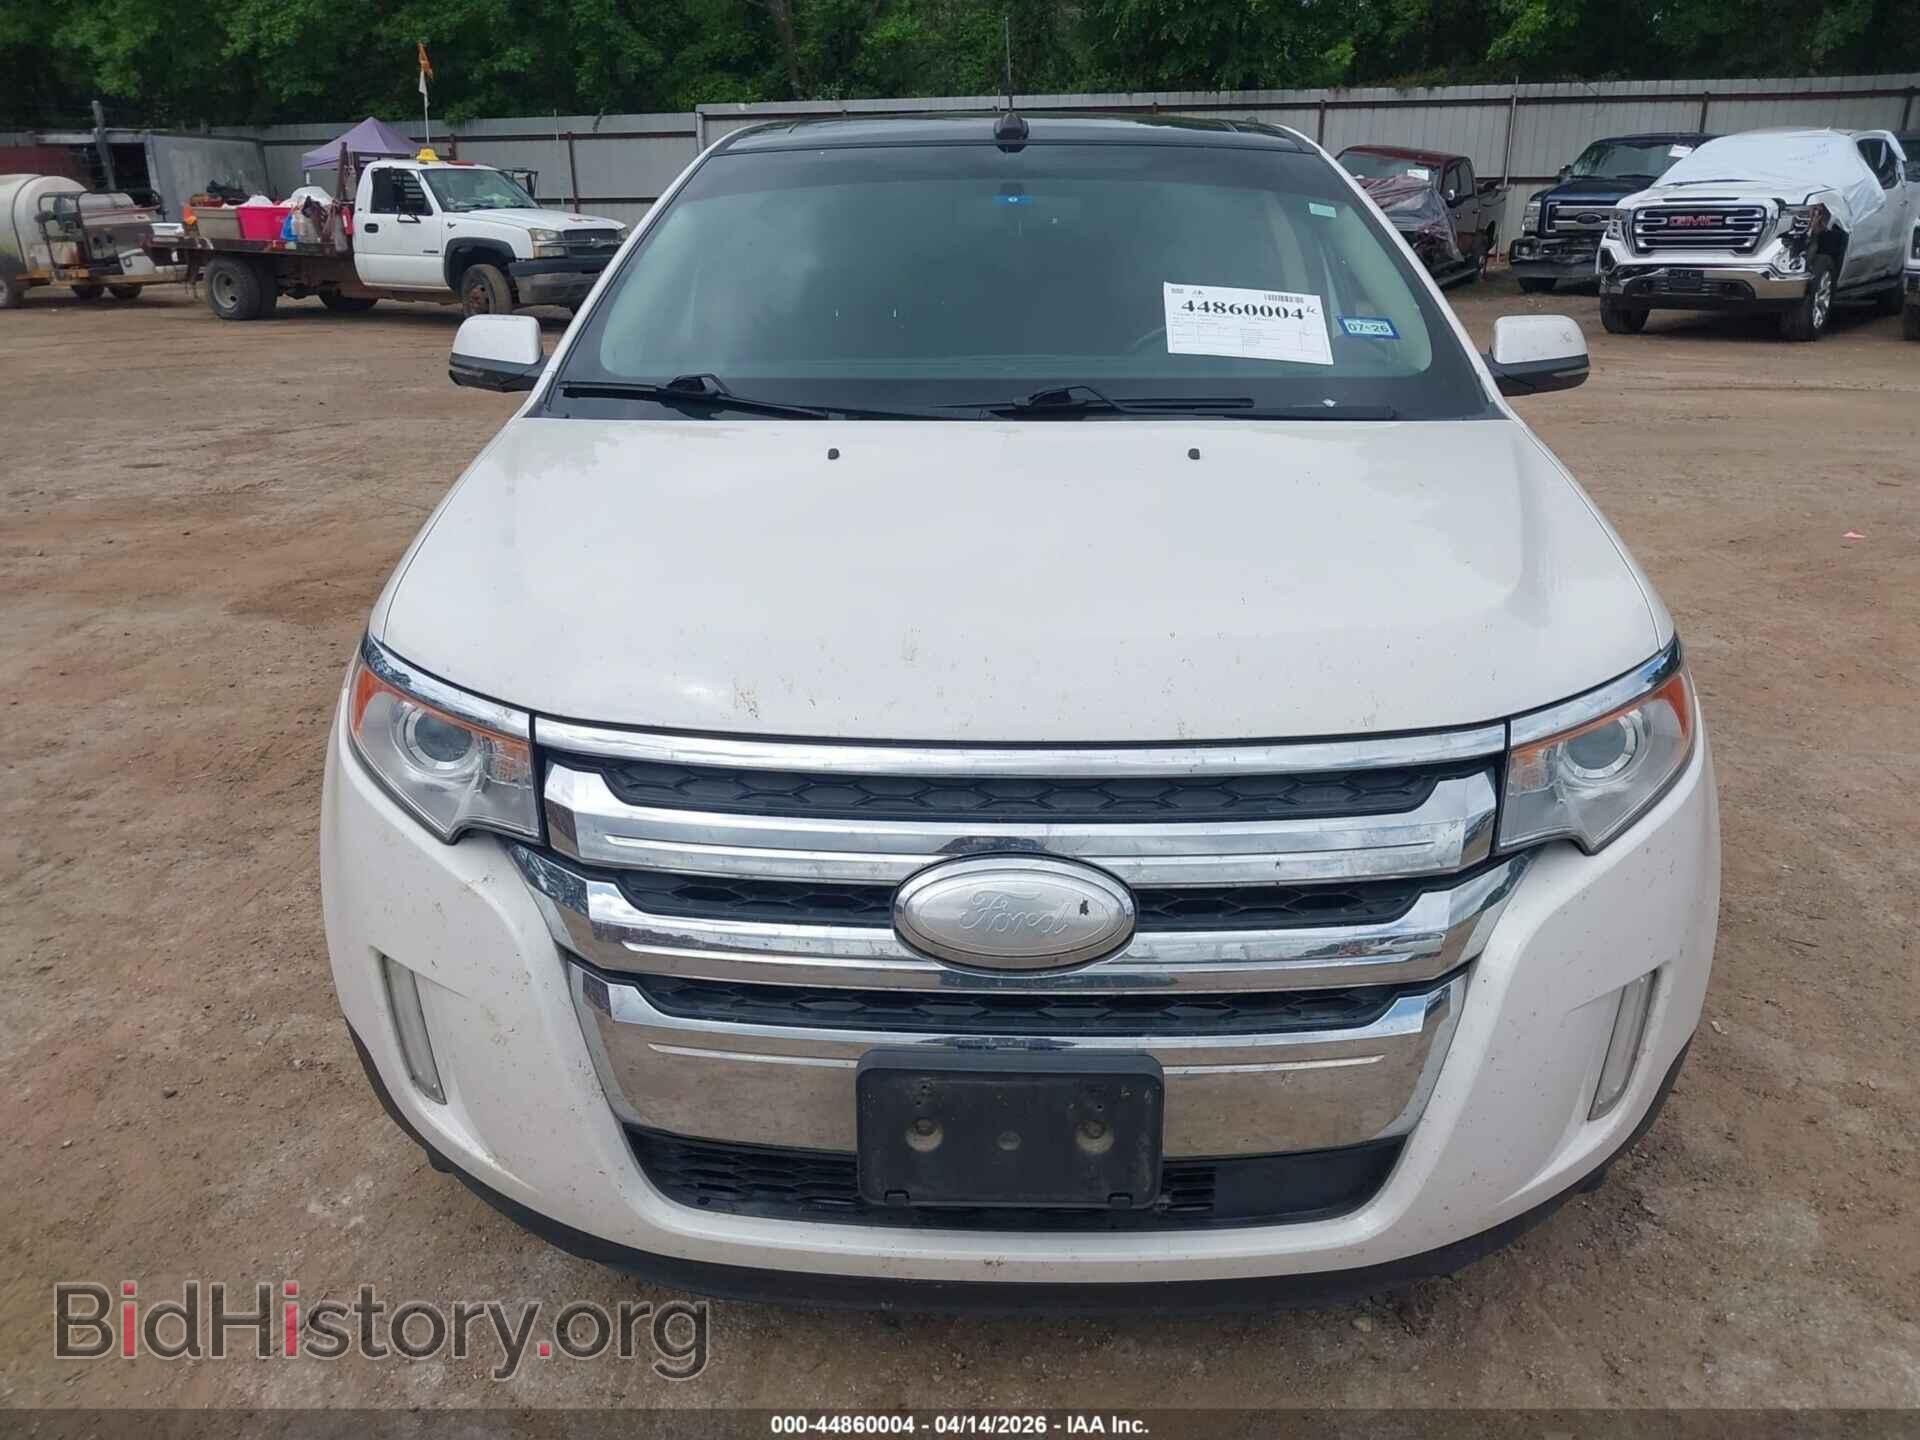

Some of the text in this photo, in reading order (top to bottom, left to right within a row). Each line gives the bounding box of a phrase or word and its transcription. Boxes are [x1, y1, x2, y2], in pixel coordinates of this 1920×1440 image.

[1669, 215, 1723, 226] GMC
[1181, 299, 1304, 320] 44860004
[959, 889, 1069, 935] Ford
